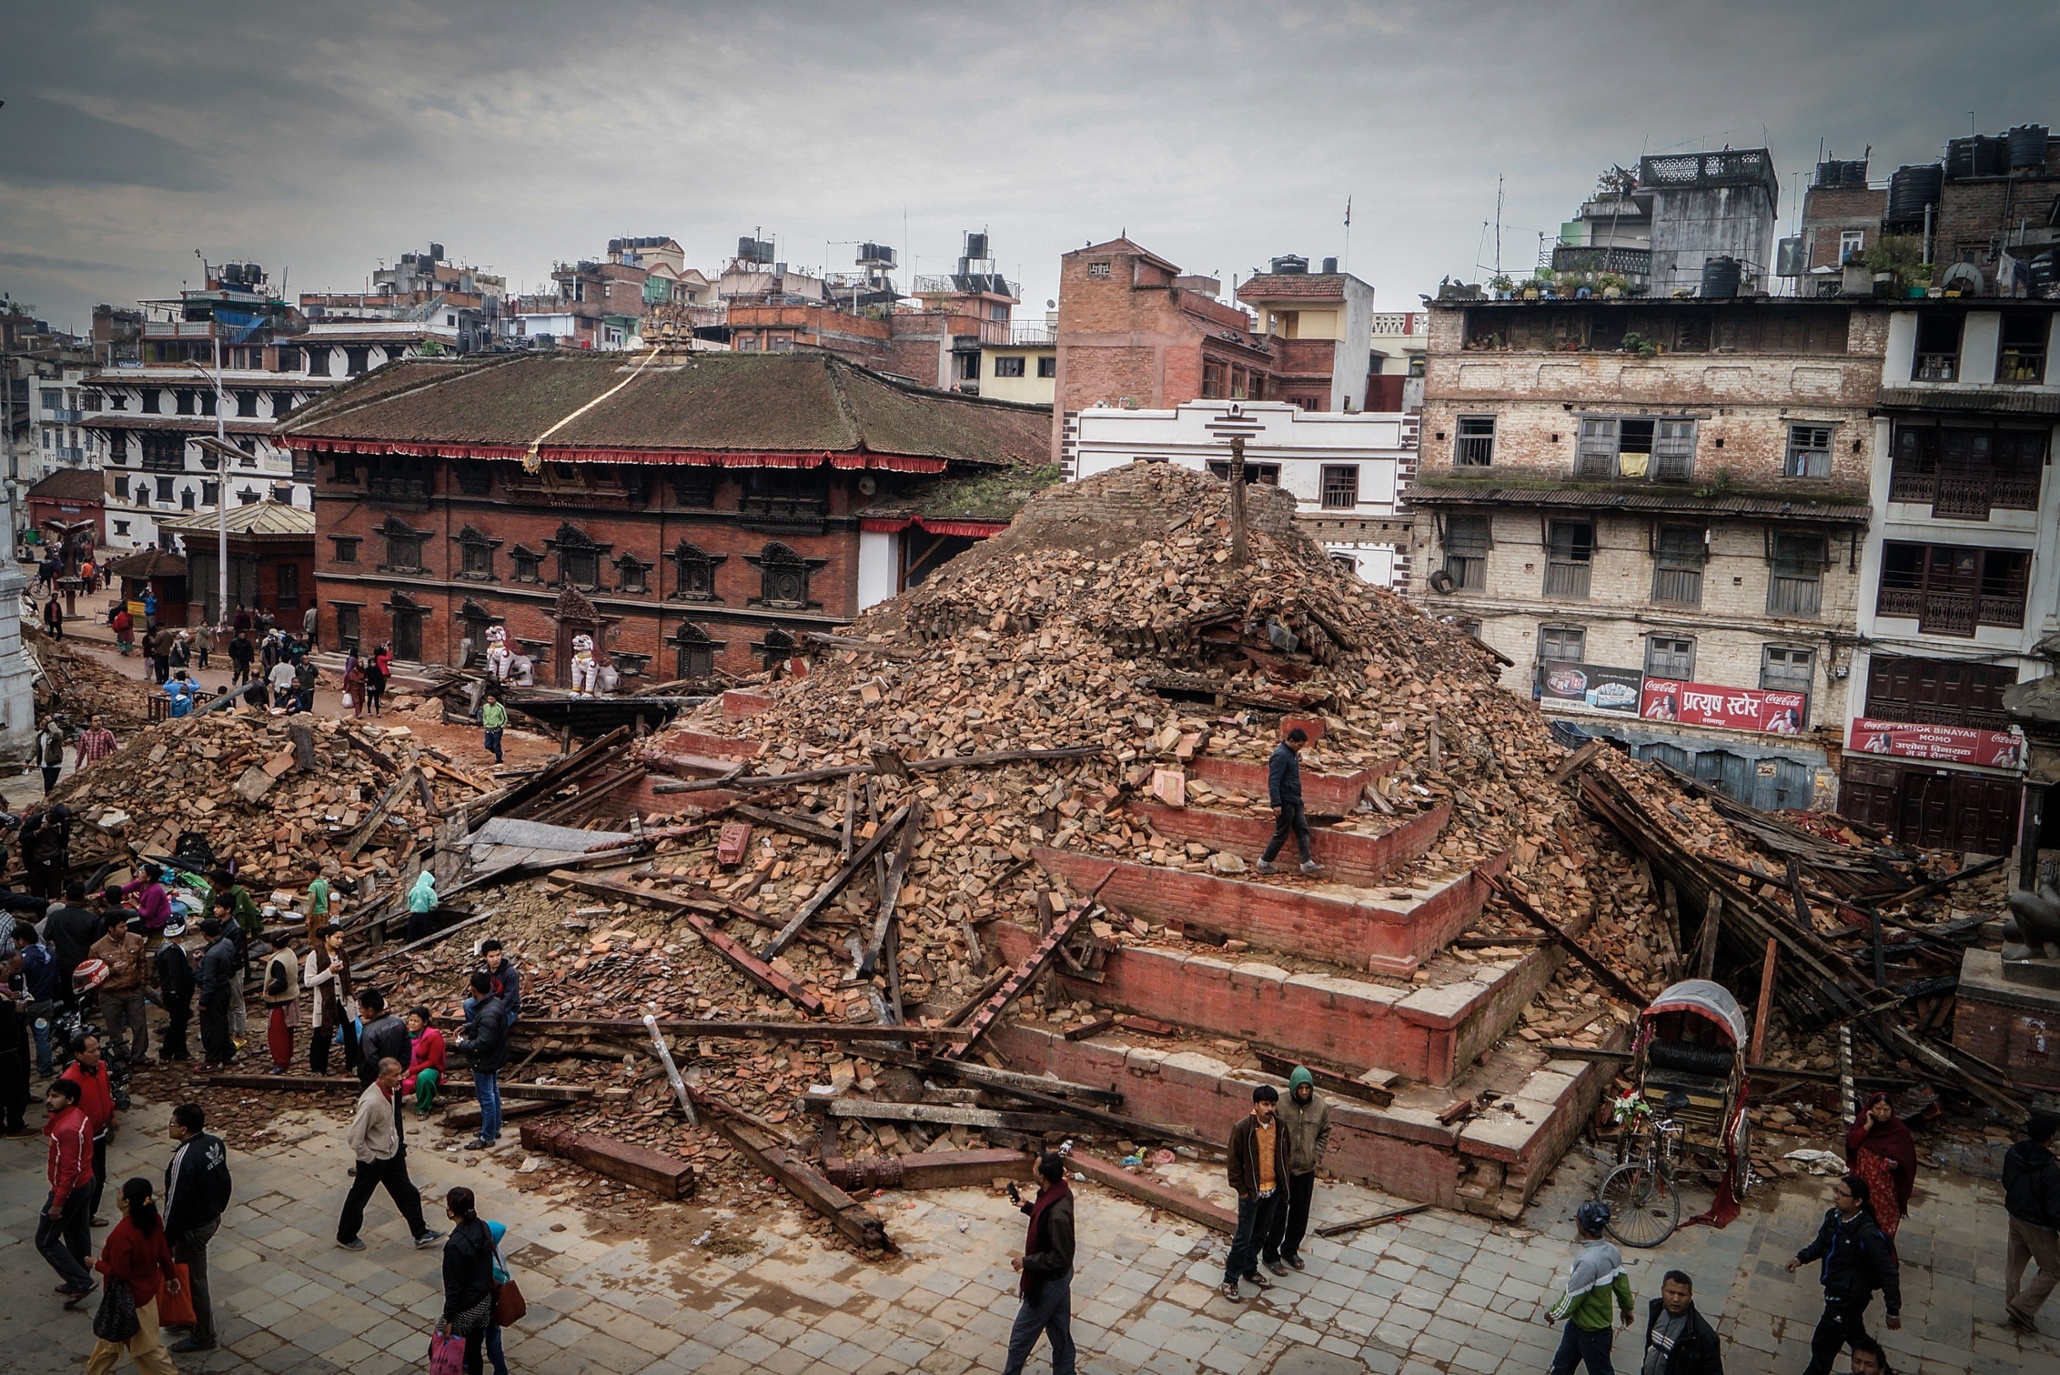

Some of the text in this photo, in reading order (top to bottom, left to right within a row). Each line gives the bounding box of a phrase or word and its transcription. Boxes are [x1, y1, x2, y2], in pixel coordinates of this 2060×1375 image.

[1683, 691, 1761, 718] प्रत्युष स्टोर
[1897, 724, 1977, 739] ASHOK BINAYAK
[1919, 734, 1952, 744] MOMO
[1895, 742, 1929, 751] अशोक
